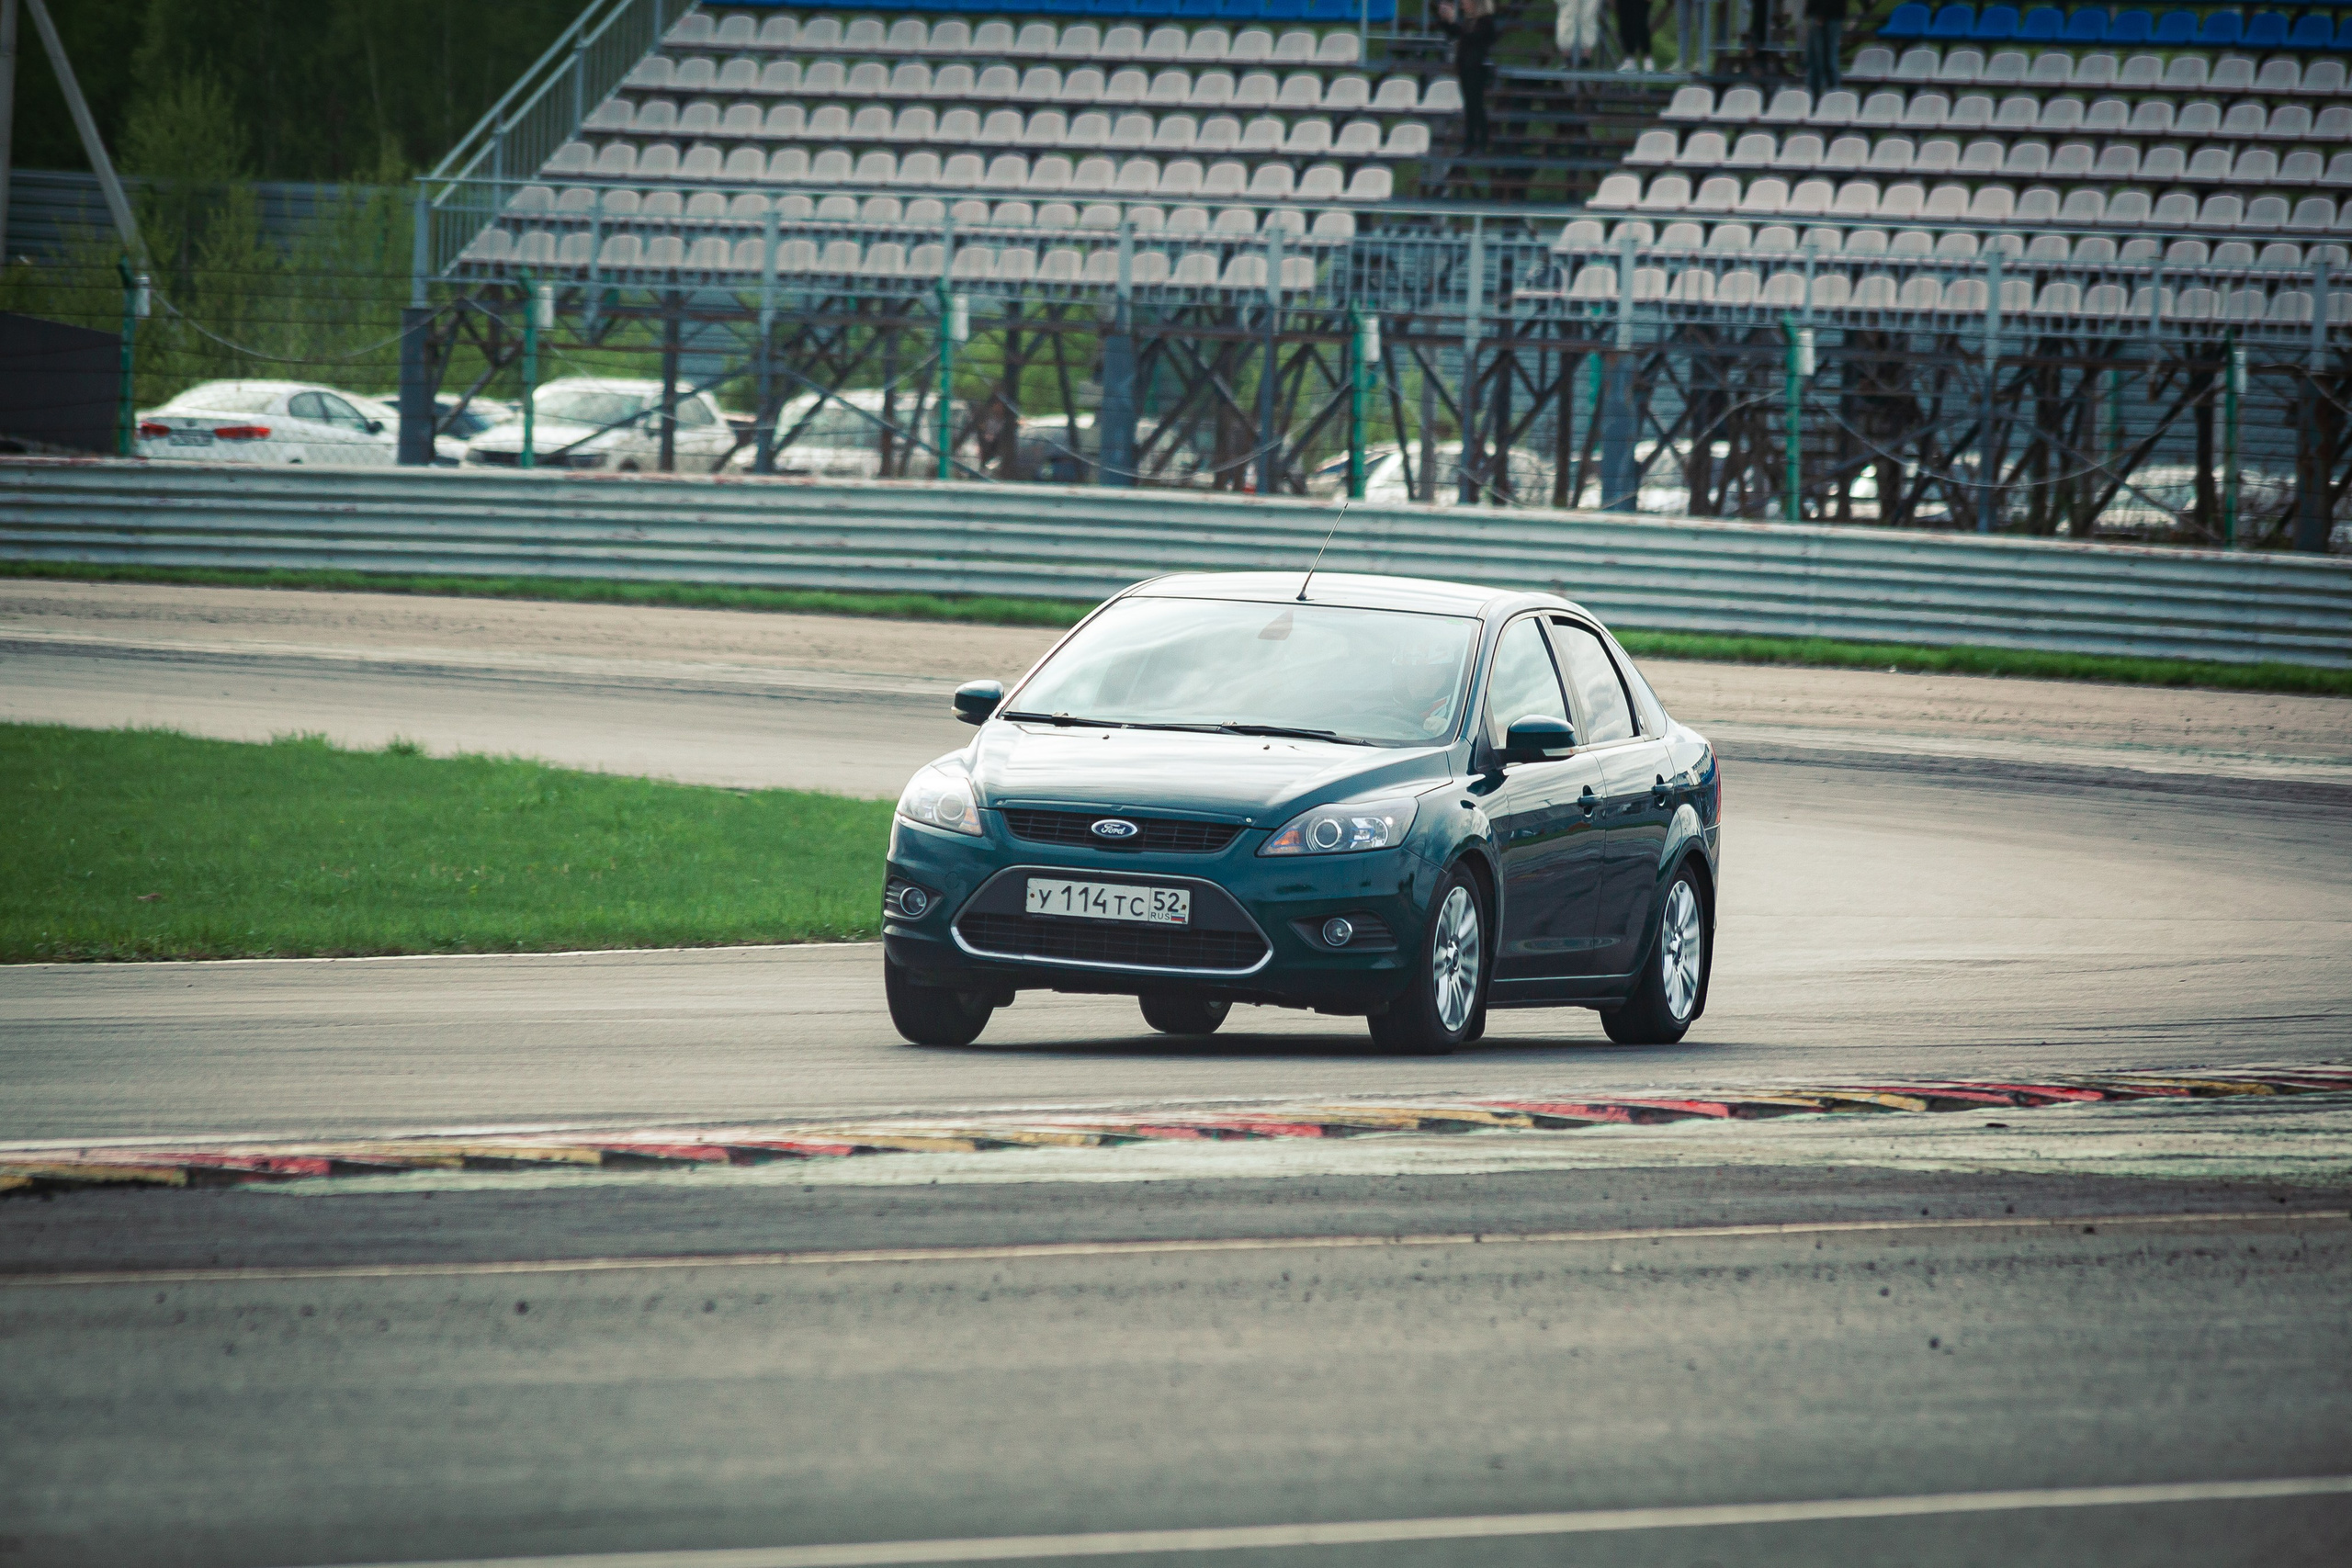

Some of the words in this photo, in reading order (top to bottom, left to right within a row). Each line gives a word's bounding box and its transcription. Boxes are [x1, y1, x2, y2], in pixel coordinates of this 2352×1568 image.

[1101, 824, 1126, 835] Ford
[1153, 891, 1181, 913] 52
[1150, 912, 1170, 920] RUS
